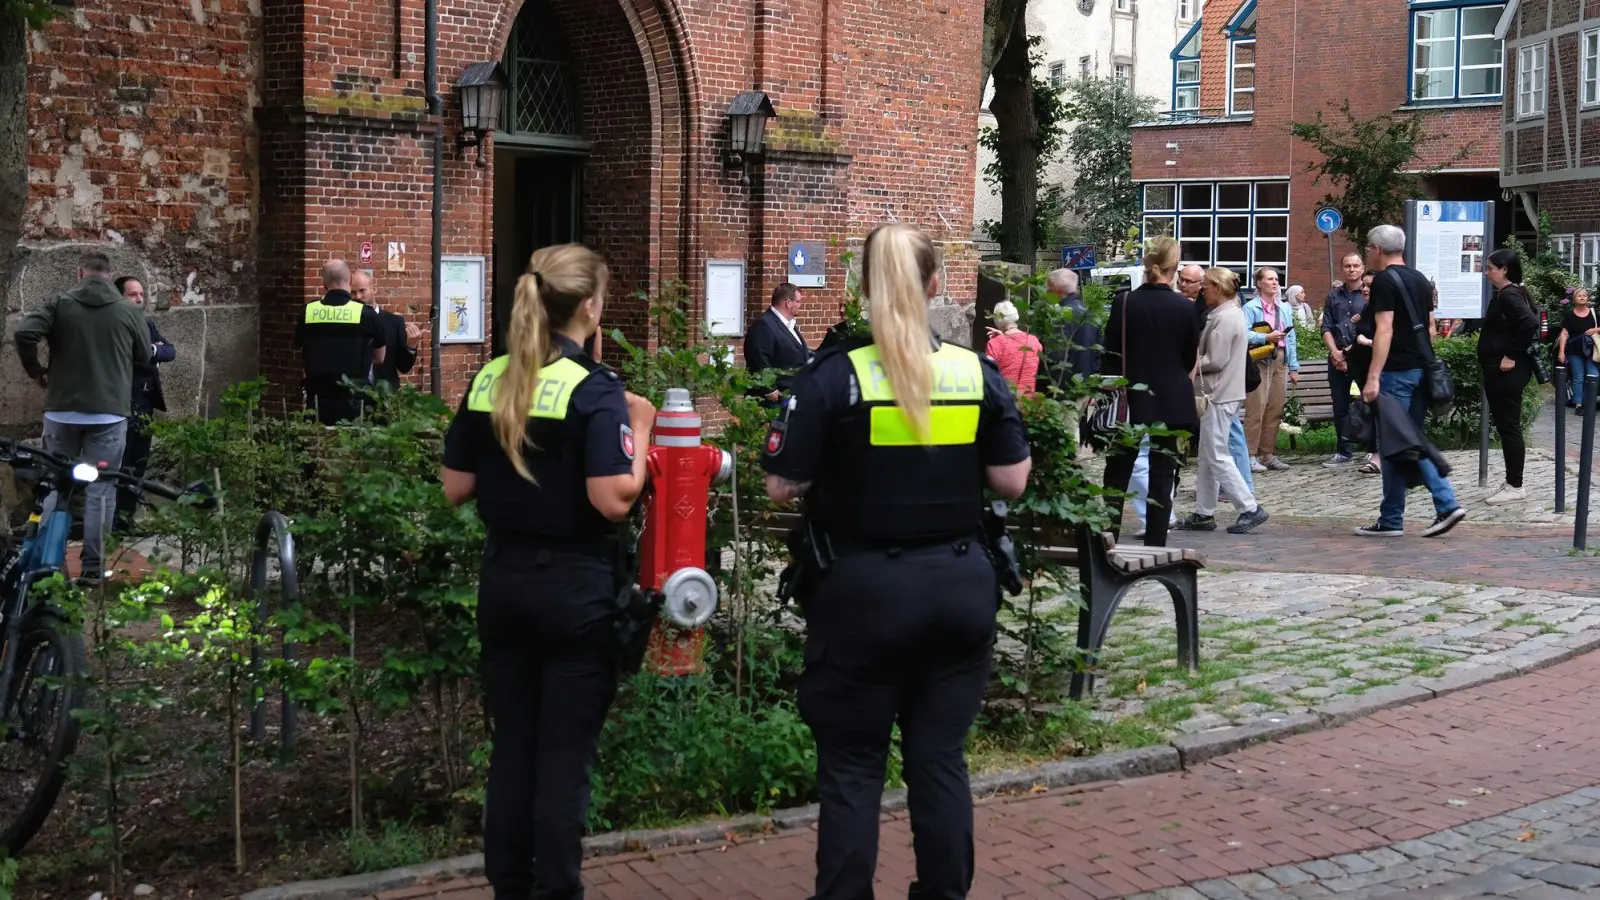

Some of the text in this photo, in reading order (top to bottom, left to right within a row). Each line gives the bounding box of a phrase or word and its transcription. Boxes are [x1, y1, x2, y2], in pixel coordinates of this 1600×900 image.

[312, 307, 353, 321] POLIZEI
[473, 373, 566, 412] POEI
[869, 359, 976, 394] PZEI
